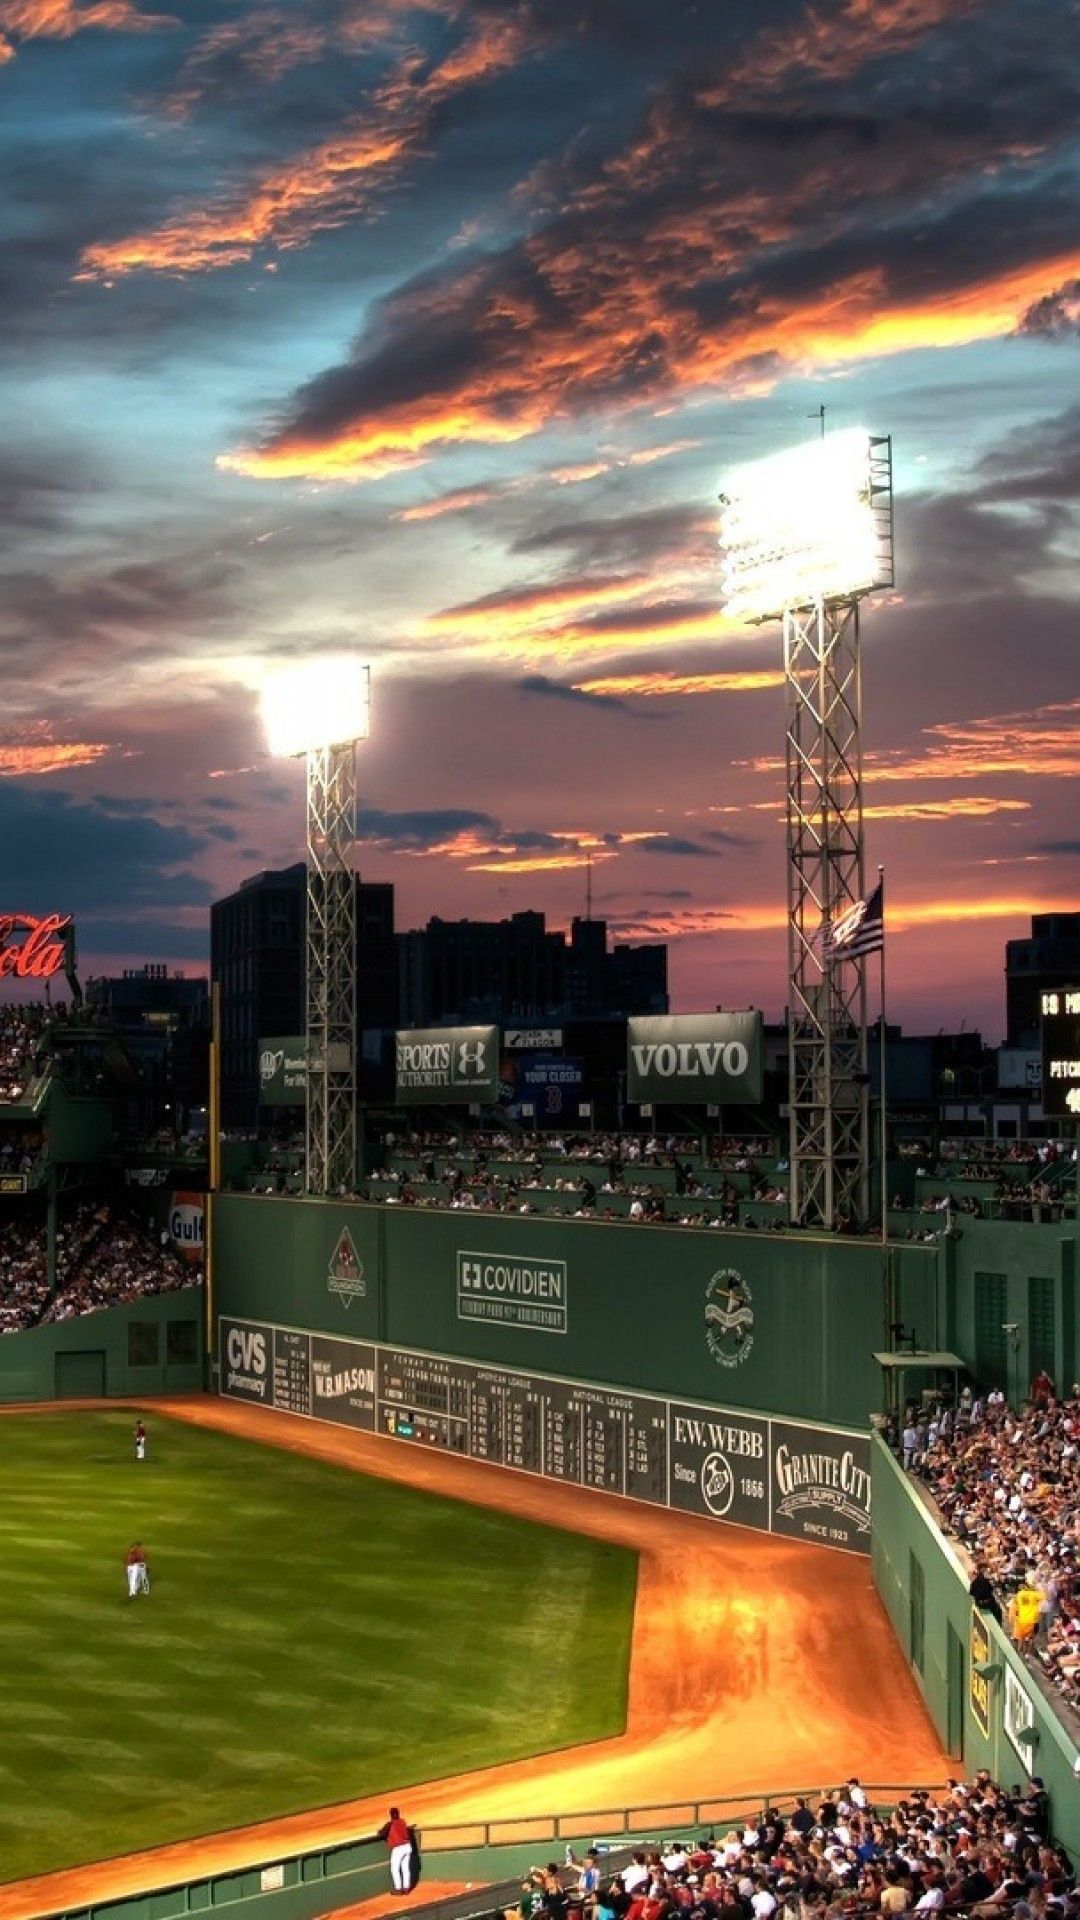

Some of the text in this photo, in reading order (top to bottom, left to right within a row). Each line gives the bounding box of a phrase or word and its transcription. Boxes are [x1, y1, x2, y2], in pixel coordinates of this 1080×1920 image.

[396, 1043, 450, 1071] SPORTS
[631, 1041, 749, 1077] VOLVO
[549, 1072, 582, 1083] CLOSER
[484, 1265, 561, 1299] COVIDIEN
[228, 1328, 266, 1374] CVS
[477, 1371, 507, 1384] AMERICAN
[508, 1377, 532, 1389] LEAGUE
[573, 1390, 633, 1409] NATIONAL LEAGUE
[674, 1463, 697, 1483] Since
[775, 1444, 840, 1496] GRANITE
[741, 1478, 765, 1500] 1866
[803, 1521, 827, 1537] SINCE
